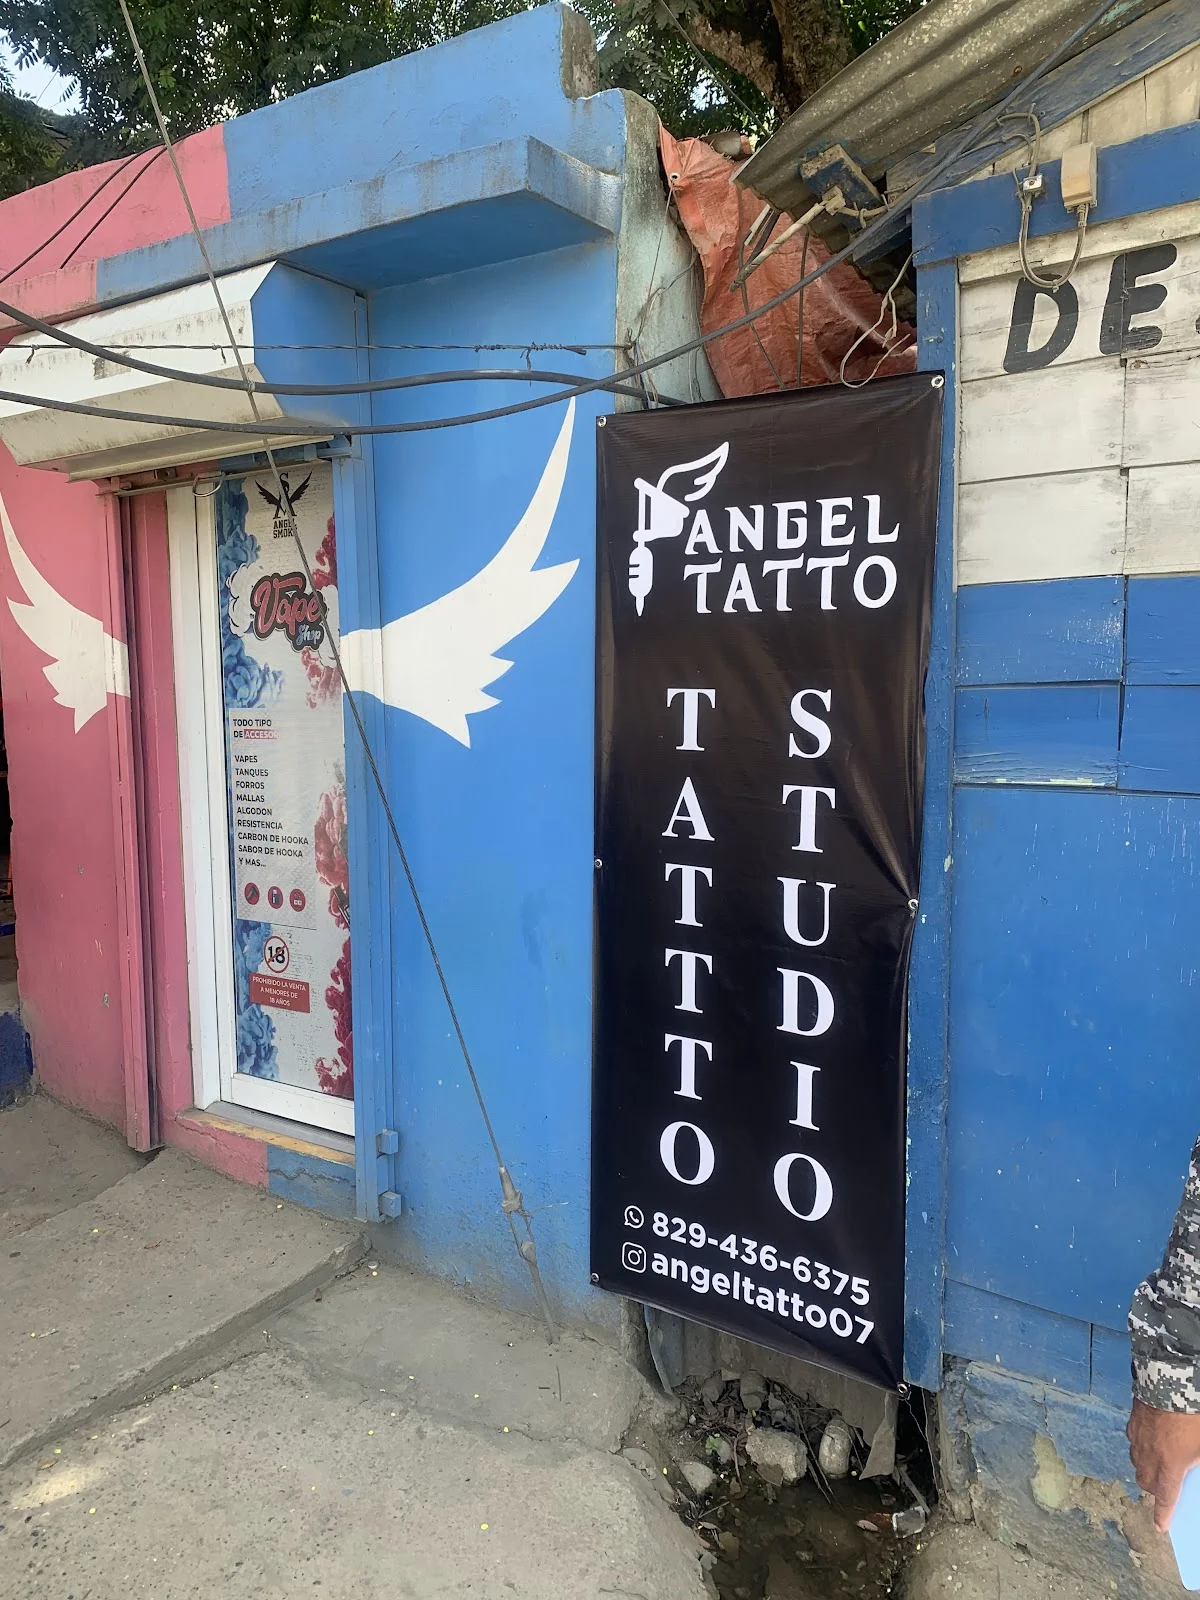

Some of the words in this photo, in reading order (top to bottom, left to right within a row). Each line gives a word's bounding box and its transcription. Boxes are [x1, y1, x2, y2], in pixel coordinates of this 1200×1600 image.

[1003, 243, 1200, 373] DE
[684, 494, 900, 554] ANGEL
[273, 528, 297, 539] SMOK
[683, 549, 898, 614] TATTO
[254, 577, 321, 636] Vape
[233, 718, 254, 727] TODO
[255, 719, 272, 727] TIPO
[234, 730, 243, 738] DE
[235, 755, 258, 763] VAPES
[235, 768, 269, 777] TANQUES
[236, 781, 265, 789] FORROS
[236, 794, 265, 802] MALLAS
[237, 806, 273, 816] ALGODON
[237, 819, 283, 830] RESISTENCIA
[238, 832, 268, 841] CARBON
[269, 835, 280, 843] DE
[281, 836, 309, 845] HOOKA
[238, 845, 263, 854] SABOR
[264, 847, 274, 855] DE
[276, 848, 303, 858] HOOKA
[238, 857, 244, 866] Y
[660, 688, 716, 1185] TATTO
[267, 945, 286, 964] 18
[773, 688, 837, 1222] STUDIO
[252, 976, 281, 987] PROHIBIDO
[288, 982, 307, 992] VENTA
[265, 987, 290, 998] MENORES
[269, 996, 275, 1004] 18
[275, 997, 291, 1007] AÑOS
[652, 1211, 870, 1306] 829-436-6375
[651, 1252, 876, 1345] angeltatto07
